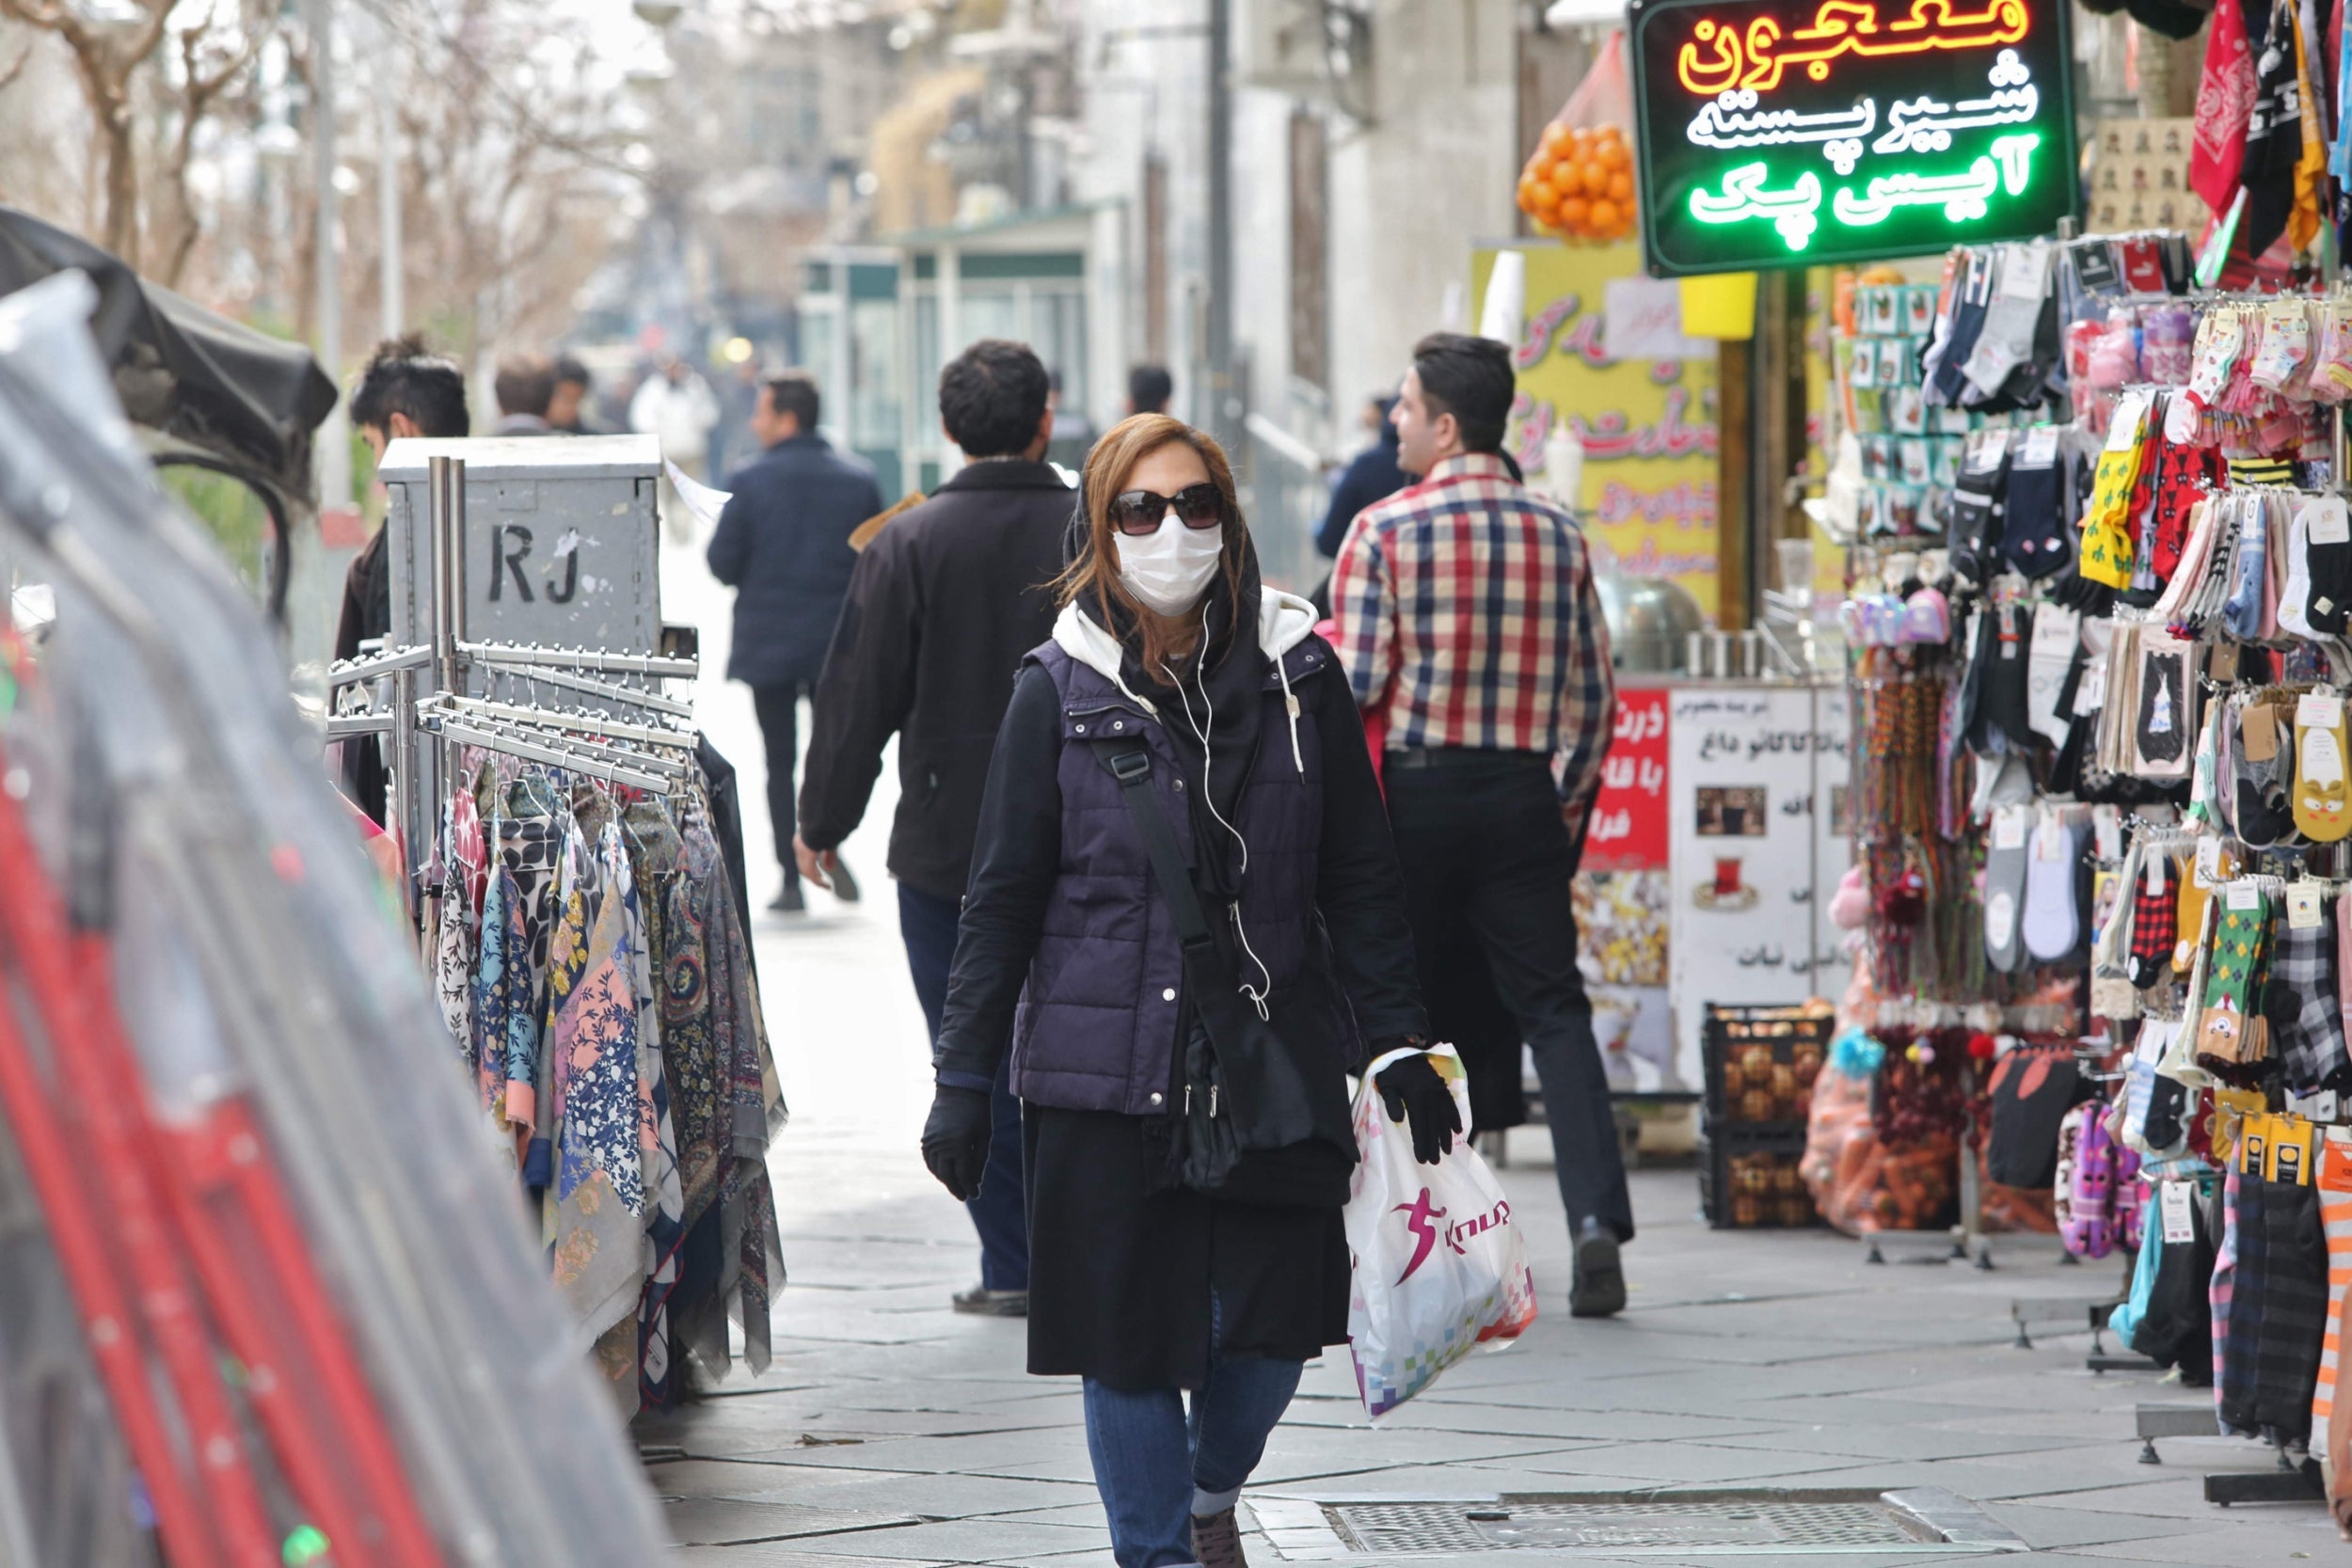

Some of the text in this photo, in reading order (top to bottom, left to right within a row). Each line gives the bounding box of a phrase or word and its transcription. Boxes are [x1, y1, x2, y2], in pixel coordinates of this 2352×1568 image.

[1678, 0, 2029, 94] معجون
[1686, 47, 2040, 176] شیر پسته
[1689, 134, 2041, 252] آیس پک
